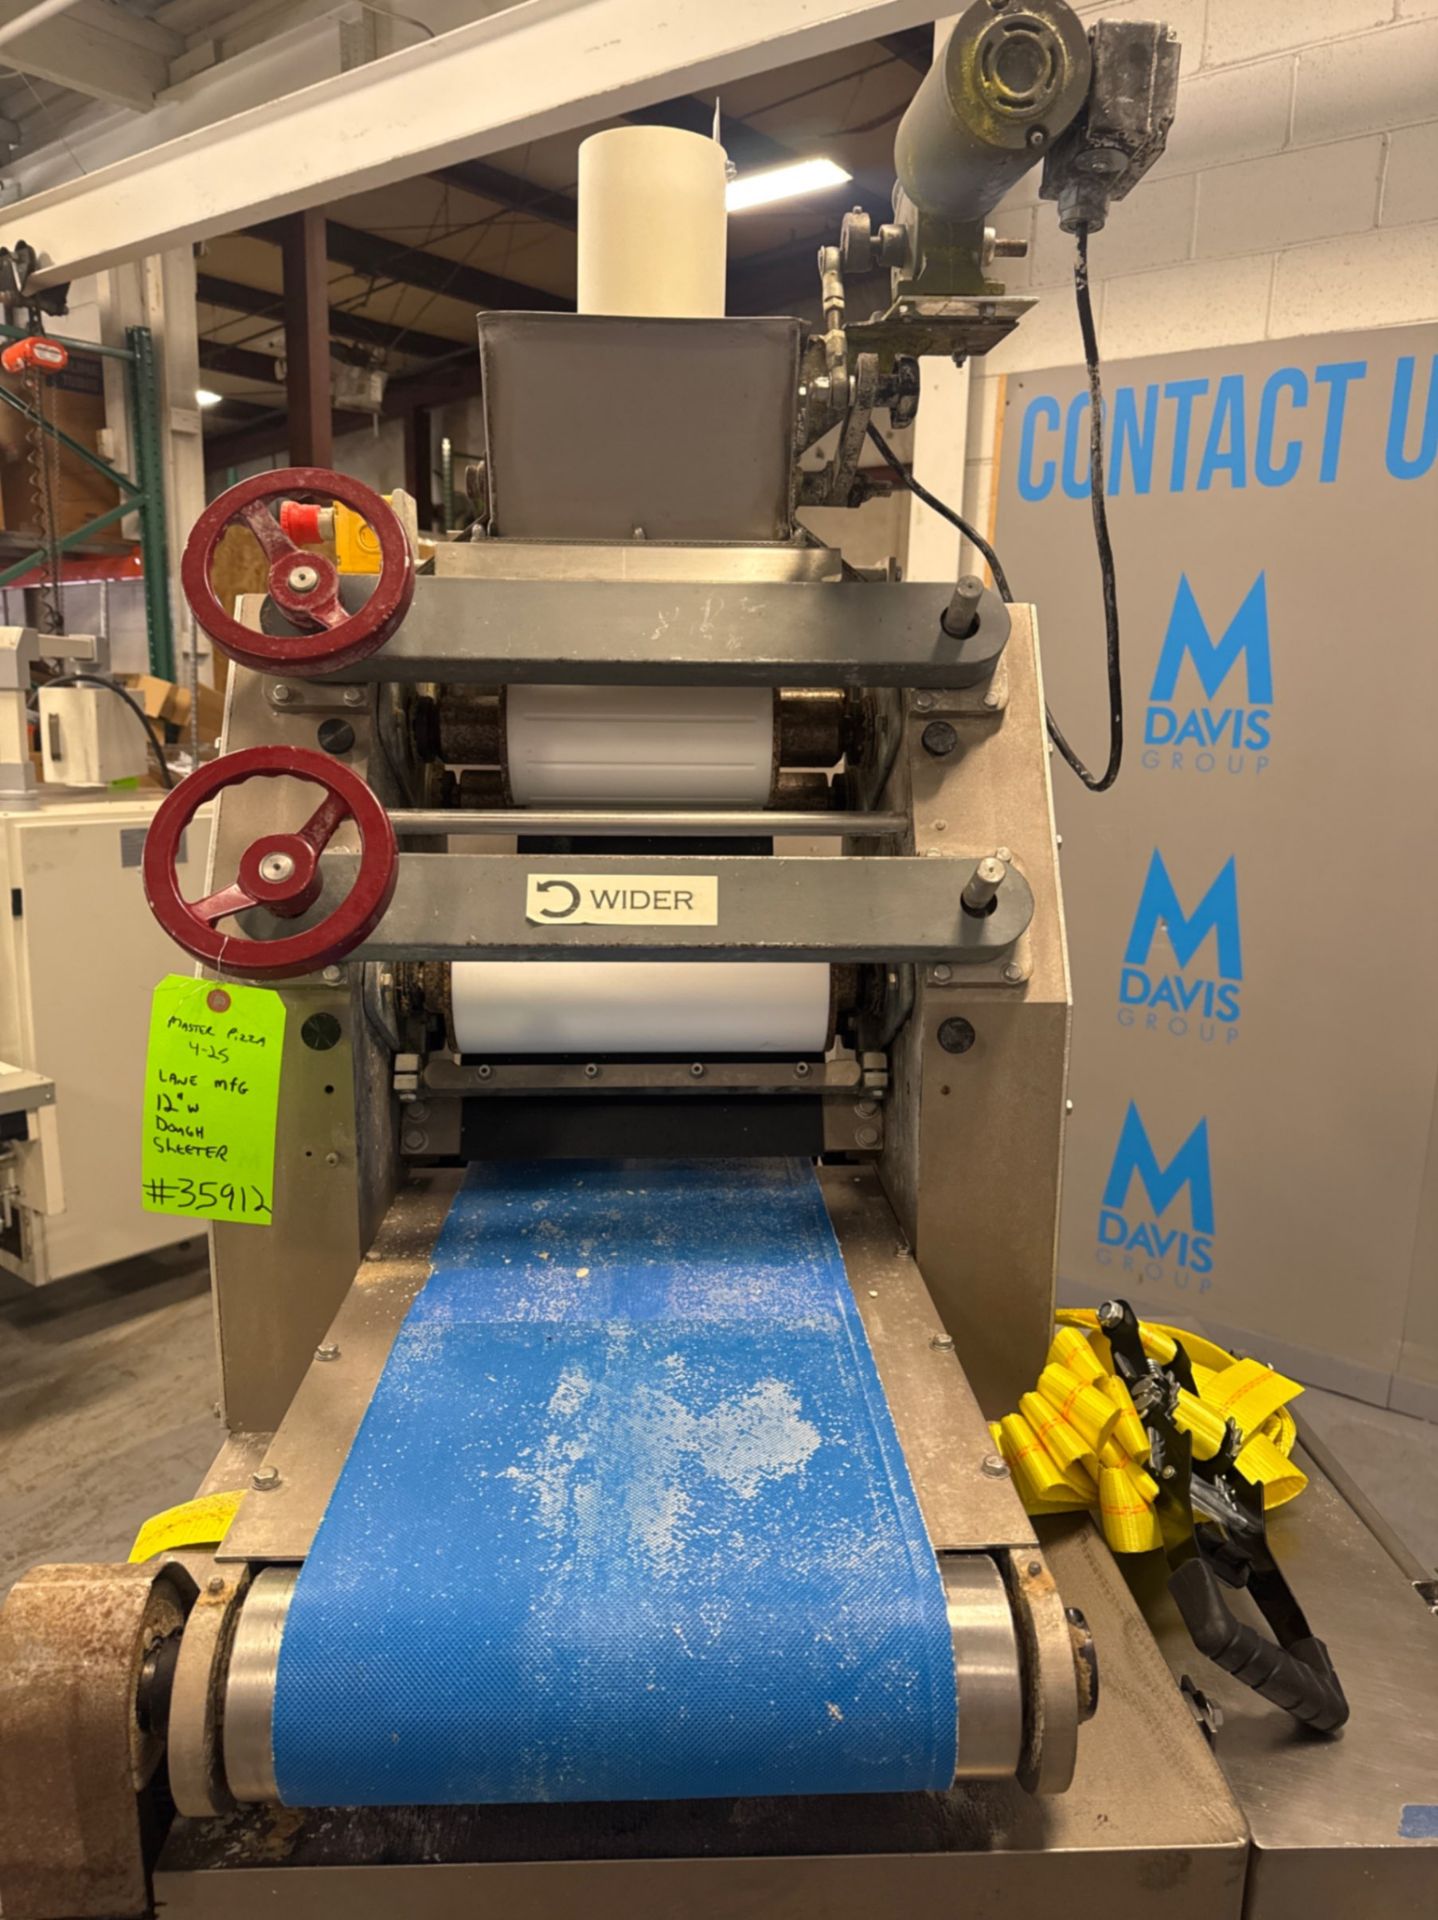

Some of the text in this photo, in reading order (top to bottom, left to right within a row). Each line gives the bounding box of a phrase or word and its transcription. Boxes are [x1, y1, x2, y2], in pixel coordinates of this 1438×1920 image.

[1017, 360, 1368, 502] CONTACT
[1144, 706, 1271, 751] DAVIS
[1141, 749, 1271, 775] GROUP
[590, 889, 694, 911] WIDER
[1119, 967, 1241, 1023] DAVIS
[167, 1015, 216, 1037] MASTER
[1117, 1008, 1239, 1044] GROUP
[188, 1040, 230, 1064] 4-25
[158, 1068, 199, 1087] LANE
[142, 1177, 272, 1215] #35912
[1098, 1210, 1213, 1274] DAVIS
